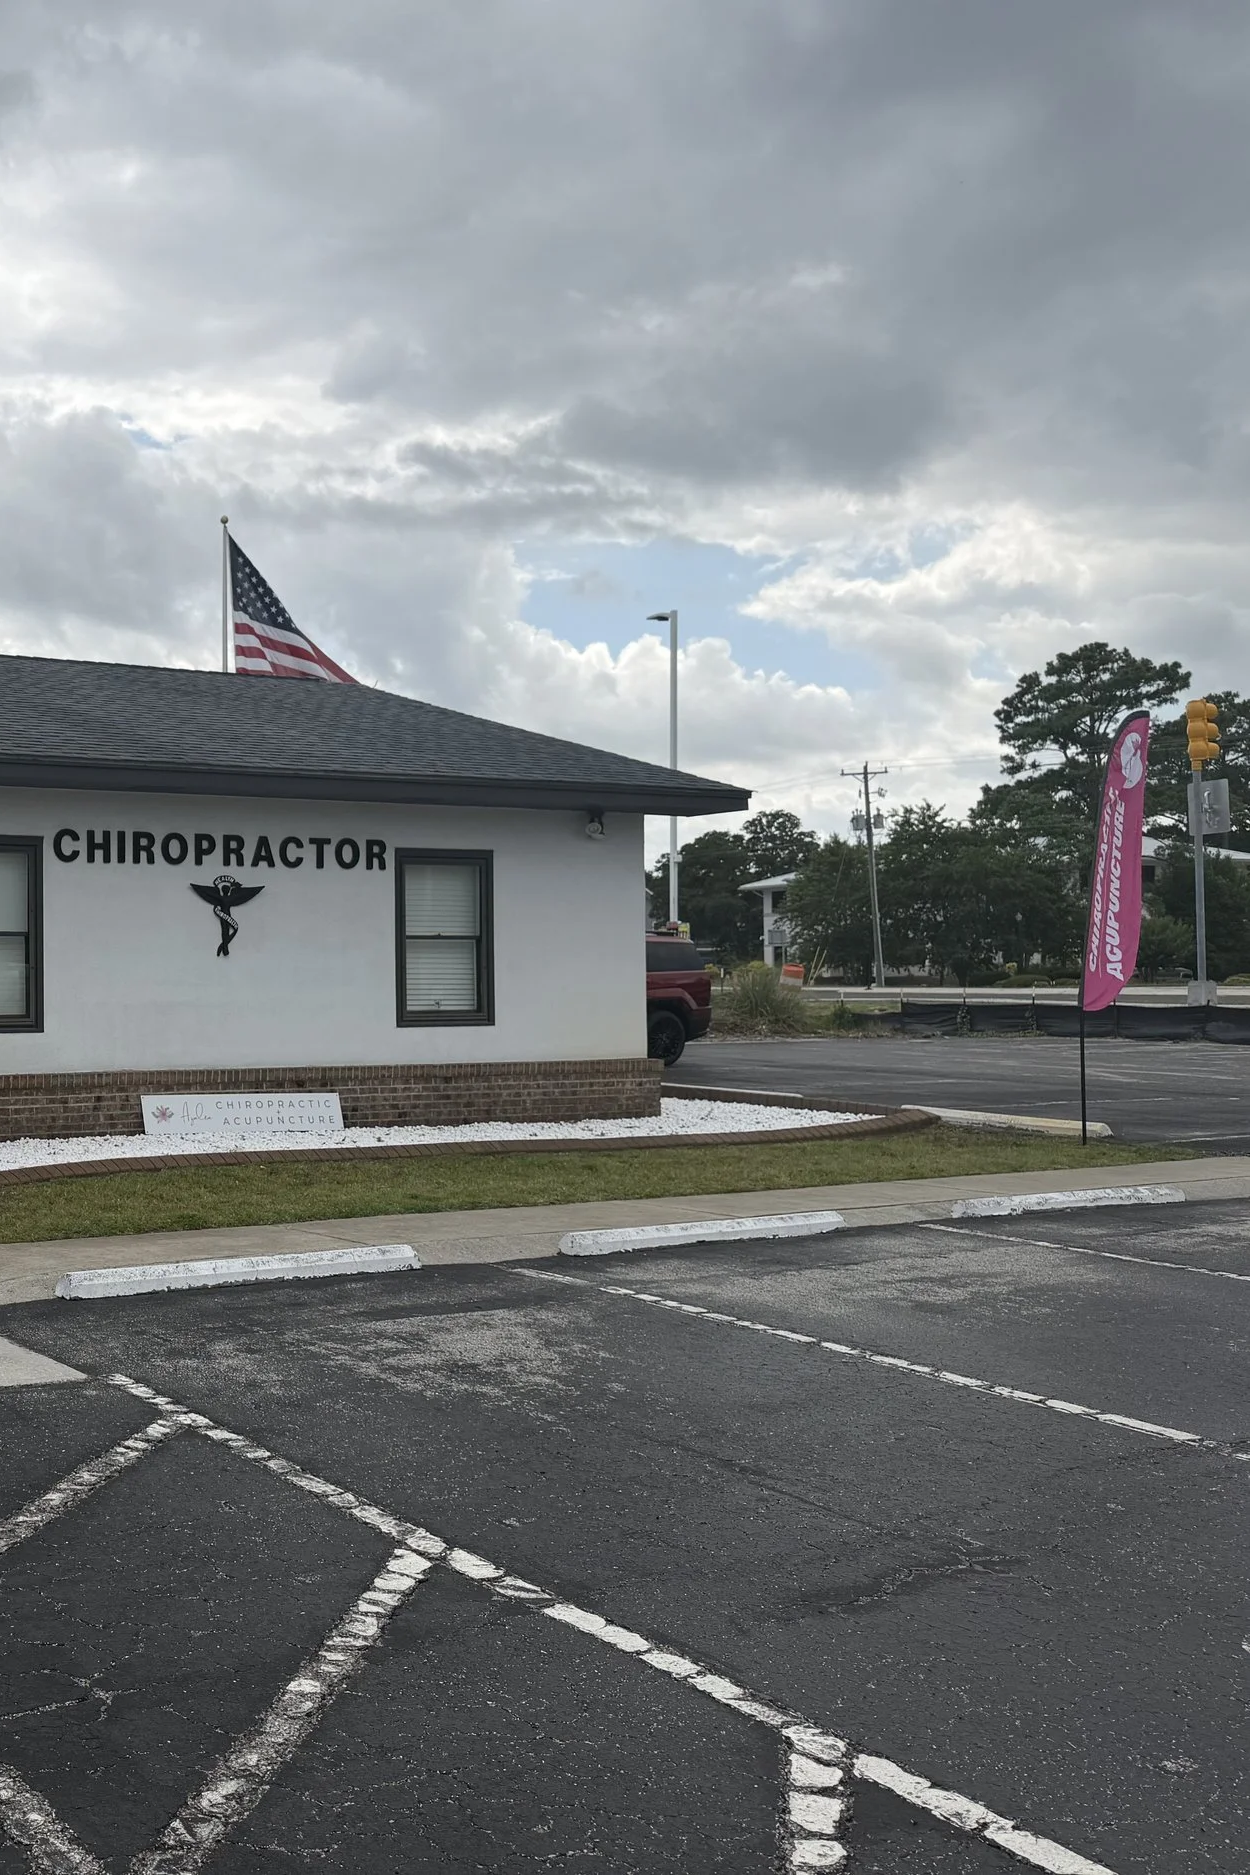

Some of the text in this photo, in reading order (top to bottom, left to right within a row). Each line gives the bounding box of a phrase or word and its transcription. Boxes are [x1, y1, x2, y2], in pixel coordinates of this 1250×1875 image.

[53, 829, 387, 871] CHIROPRACTOR
[214, 876, 235, 885] HEALTH
[1106, 801, 1125, 981] ACUPUNCTURE
[215, 1100, 332, 1110] CHIROPRACTIC
[223, 1115, 336, 1126] ACUPUNCTURE
